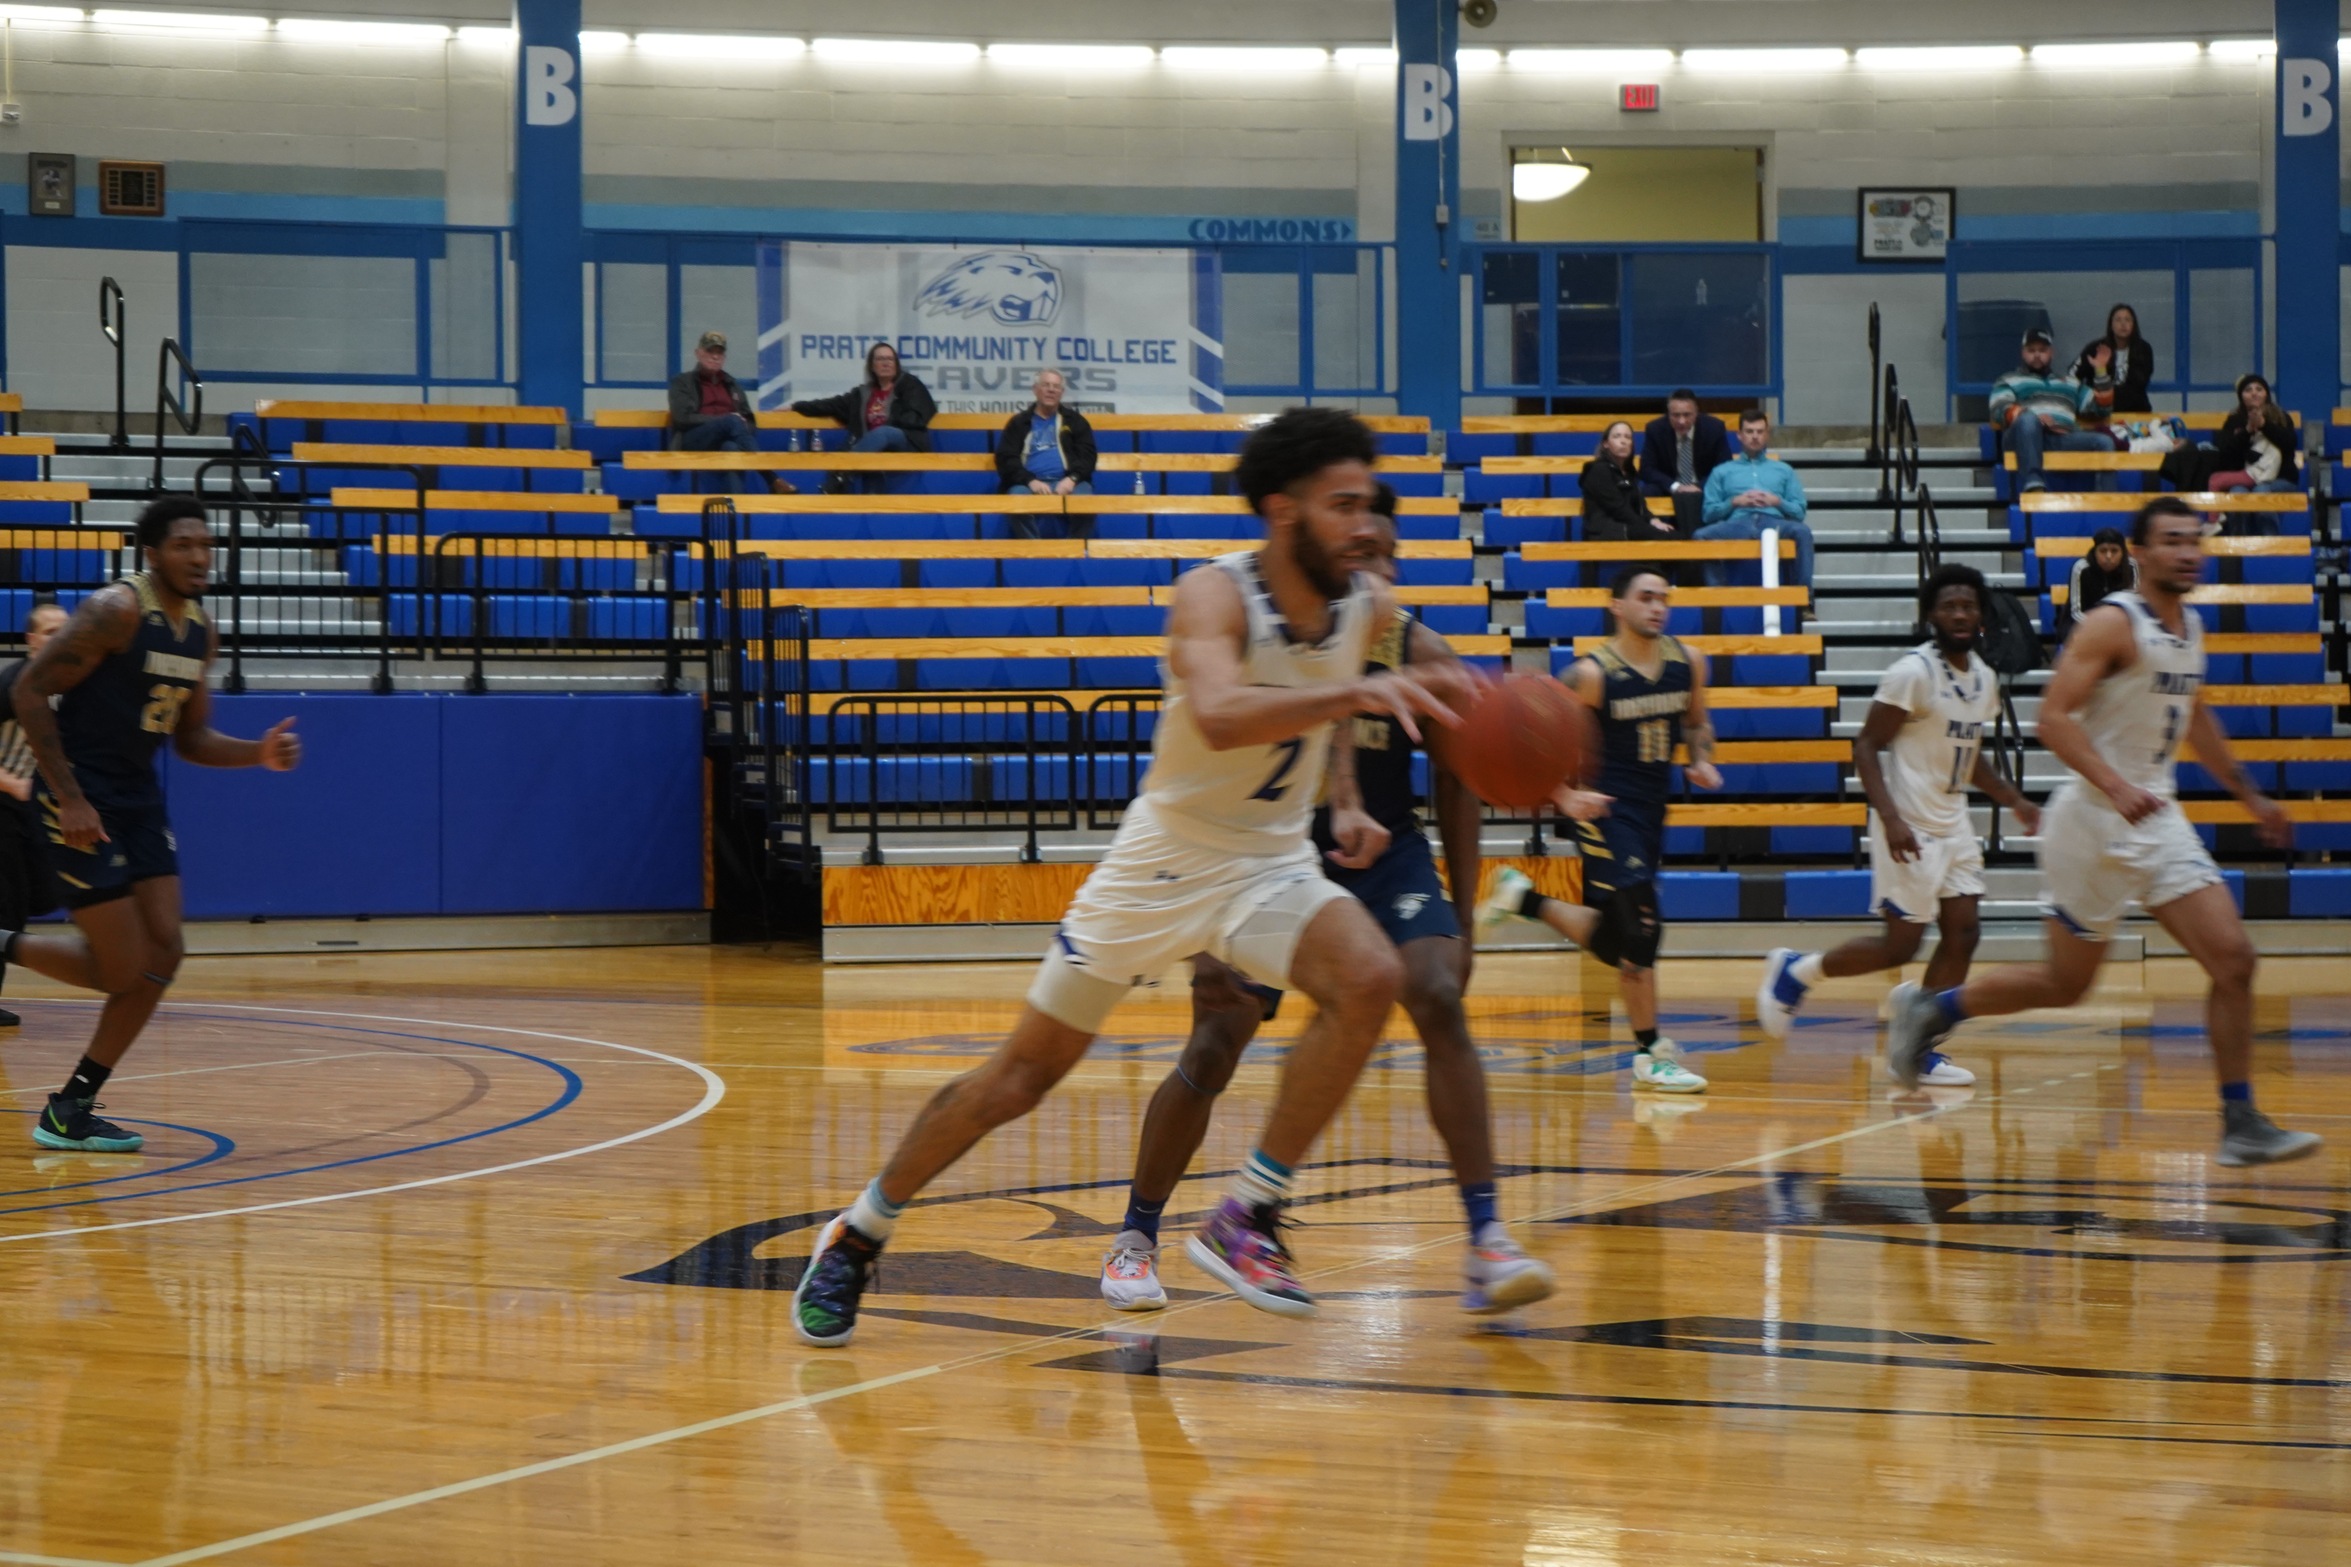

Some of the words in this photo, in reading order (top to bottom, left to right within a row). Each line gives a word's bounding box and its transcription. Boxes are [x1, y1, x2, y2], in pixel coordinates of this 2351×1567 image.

[526, 45, 577, 126] B
[1625, 85, 1655, 109] EXIT
[2282, 58, 2333, 137] B
[1404, 63, 1454, 141] B
[1188, 219, 1338, 241] COMMONS
[896, 336, 1047, 361] COMMUNITY
[1056, 337, 1177, 364] COLLEGE
[902, 366, 1117, 392] EAVERS
[981, 402, 1037, 415] HOUS
[1248, 736, 1306, 802] 2
